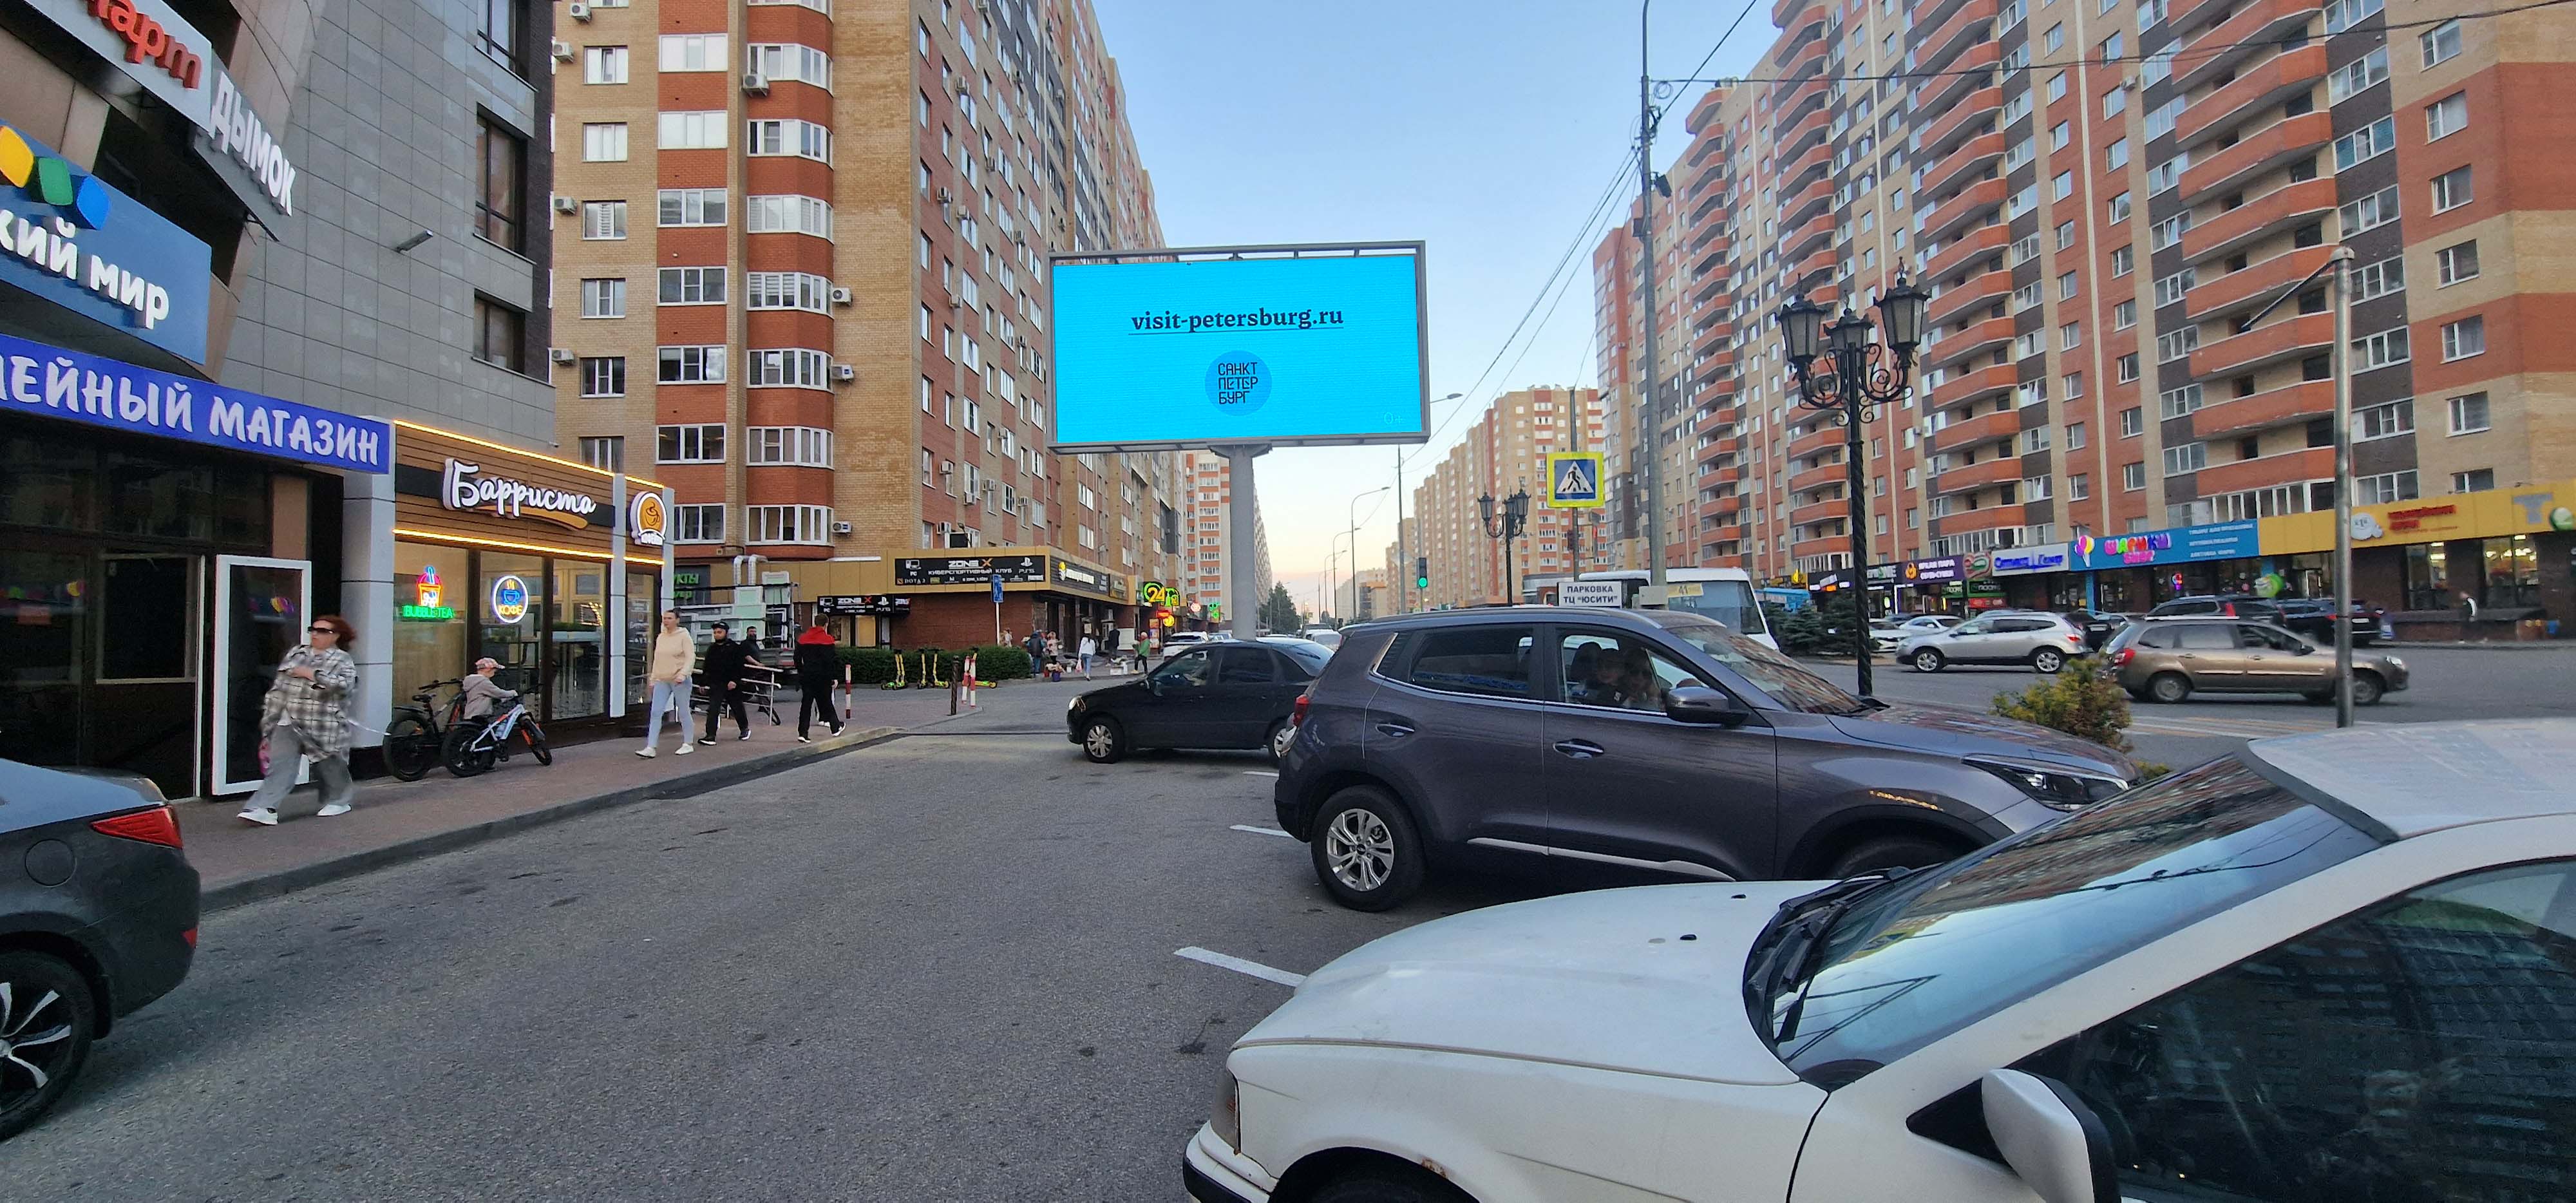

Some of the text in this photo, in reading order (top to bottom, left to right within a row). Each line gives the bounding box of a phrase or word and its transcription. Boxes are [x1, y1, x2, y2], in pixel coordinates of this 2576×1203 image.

[86, 0, 202, 89] арт
[209, 71, 297, 216] ДЫМОК
[90, 254, 169, 330] мир
[1132, 308, 1344, 332] visit-petersburg.ru
[1218, 362, 1258, 375] САНКТ
[1218, 377, 1258, 390] ПЕТЕР
[1218, 391, 1250, 404] БУРГ
[0, 355, 379, 466] ЕЙНЫЙ МАГАЗИН
[446, 459, 597, 518] Барриста
[2104, 533, 2172, 555] ШАРИКИ
[949, 558, 992, 569] ZONE X
[1147, 587, 1166, 603] 24
[1564, 596, 1575, 605] ТЦ
[498, 605, 522, 615] КОФЕ
